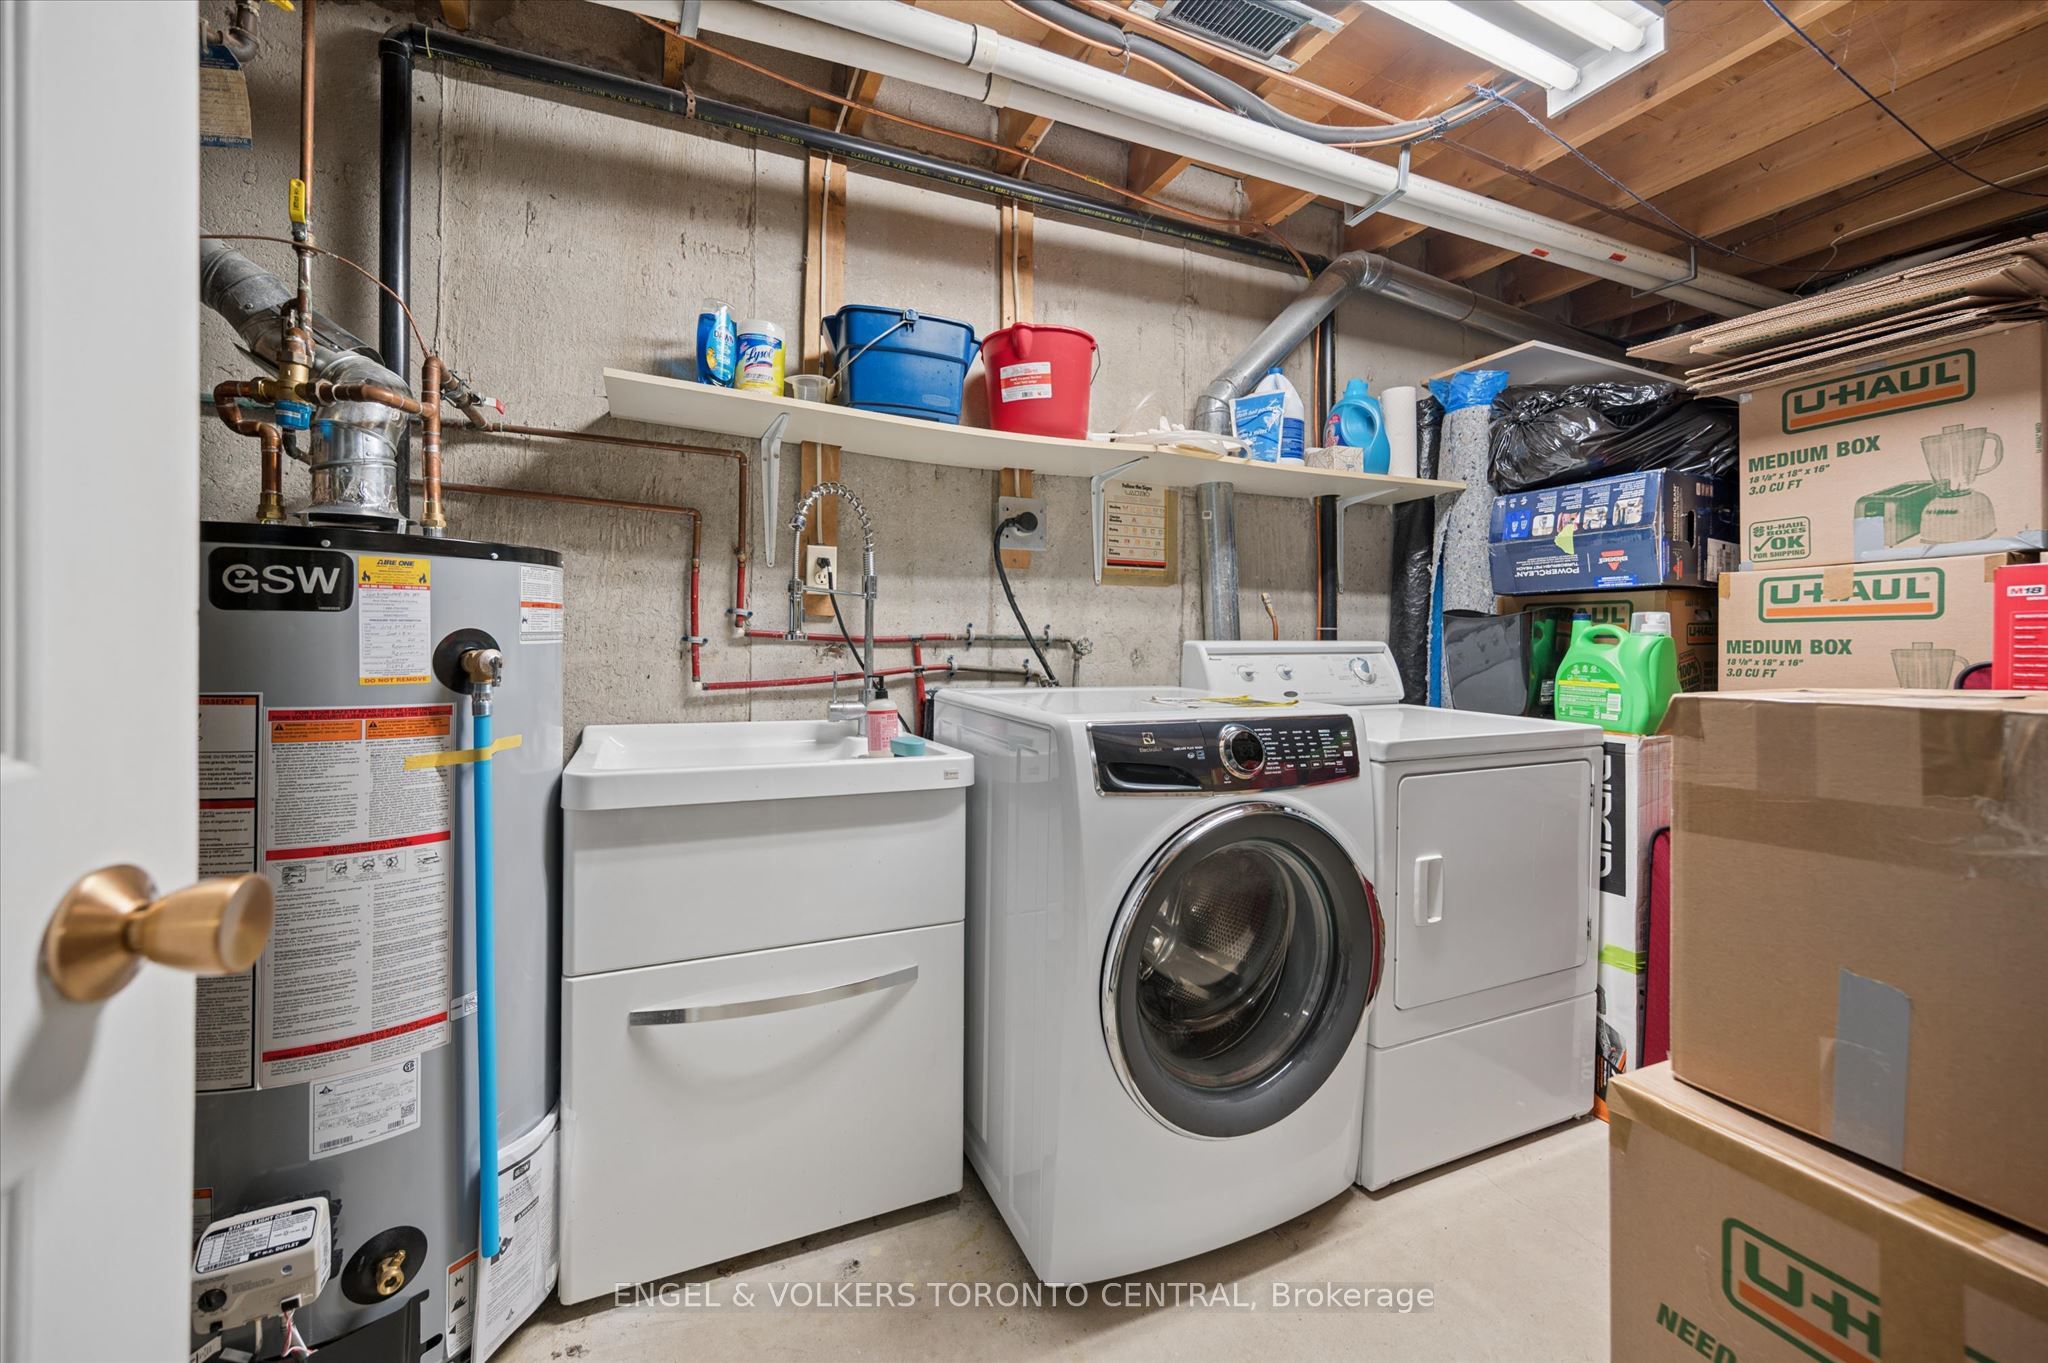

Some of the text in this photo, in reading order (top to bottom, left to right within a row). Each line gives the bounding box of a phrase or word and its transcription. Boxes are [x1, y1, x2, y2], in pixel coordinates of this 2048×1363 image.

[745, 345, 774, 362] Lysol
[1794, 361, 1960, 414] U-HAUL
[1748, 435, 1880, 473] MEDIUM BOX
[1749, 475, 1760, 484] 18
[1786, 468, 1803, 478] 18"
[1812, 464, 1830, 475] 16"
[1749, 479, 1802, 496] 3.0 CU FT
[1766, 521, 1806, 532] U-HAUL
[1766, 526, 1806, 537] BOXES
[1771, 535, 1803, 550] OK
[1753, 547, 1805, 559] FOR SHIPPING
[1516, 566, 1580, 578] POWERCLEAN
[222, 563, 341, 595] GSW
[2010, 586, 2043, 594] M18
[1726, 639, 1852, 654] MEDIUM BOX
[1763, 658, 1777, 666] 18"
[1788, 658, 1804, 666] 16"
[1726, 668, 1777, 678] 3.0 CU FT
[231, 1221, 254, 1232] STATUS
[275, 1241, 300, 1252] OUTLET
[1744, 1240, 1881, 1358] U-H
